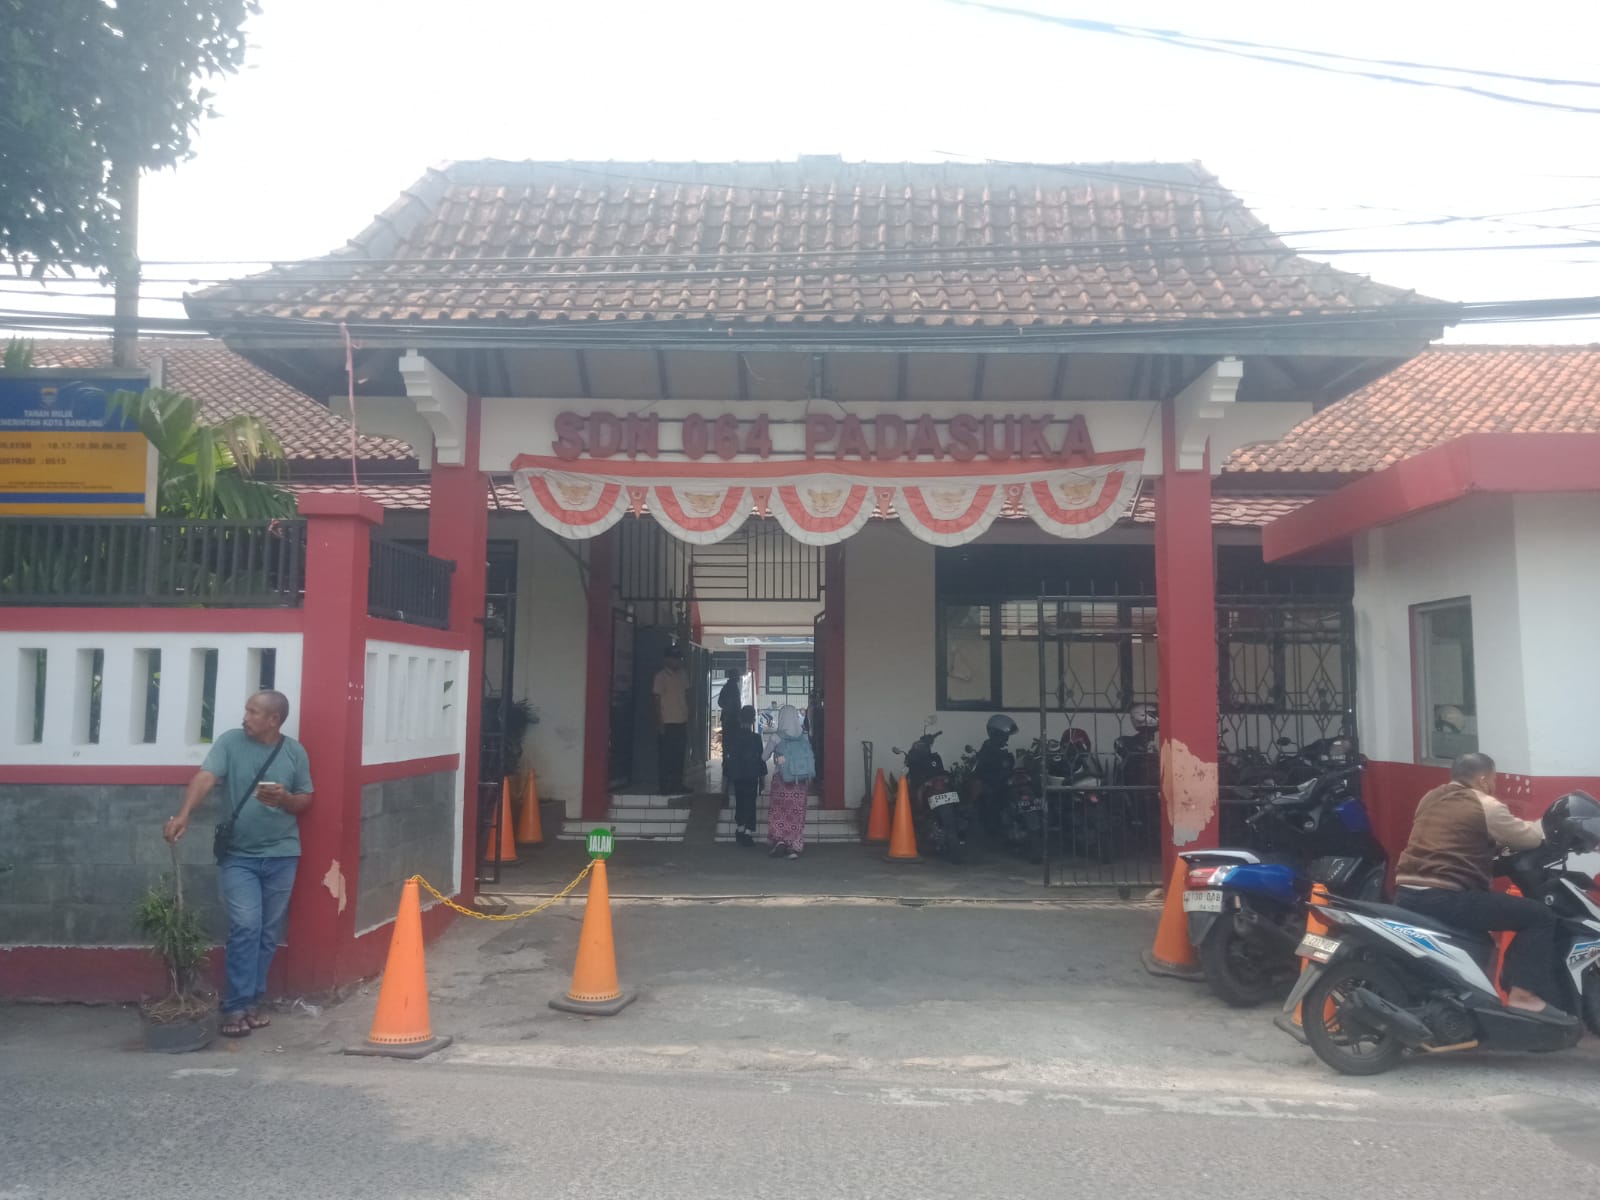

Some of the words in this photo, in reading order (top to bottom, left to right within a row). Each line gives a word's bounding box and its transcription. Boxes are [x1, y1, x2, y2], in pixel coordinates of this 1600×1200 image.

[552, 411, 659, 461] SDN
[682, 413, 773, 460] 064
[805, 413, 1096, 463] PADASUKA
[588, 835, 612, 853] JALAN
